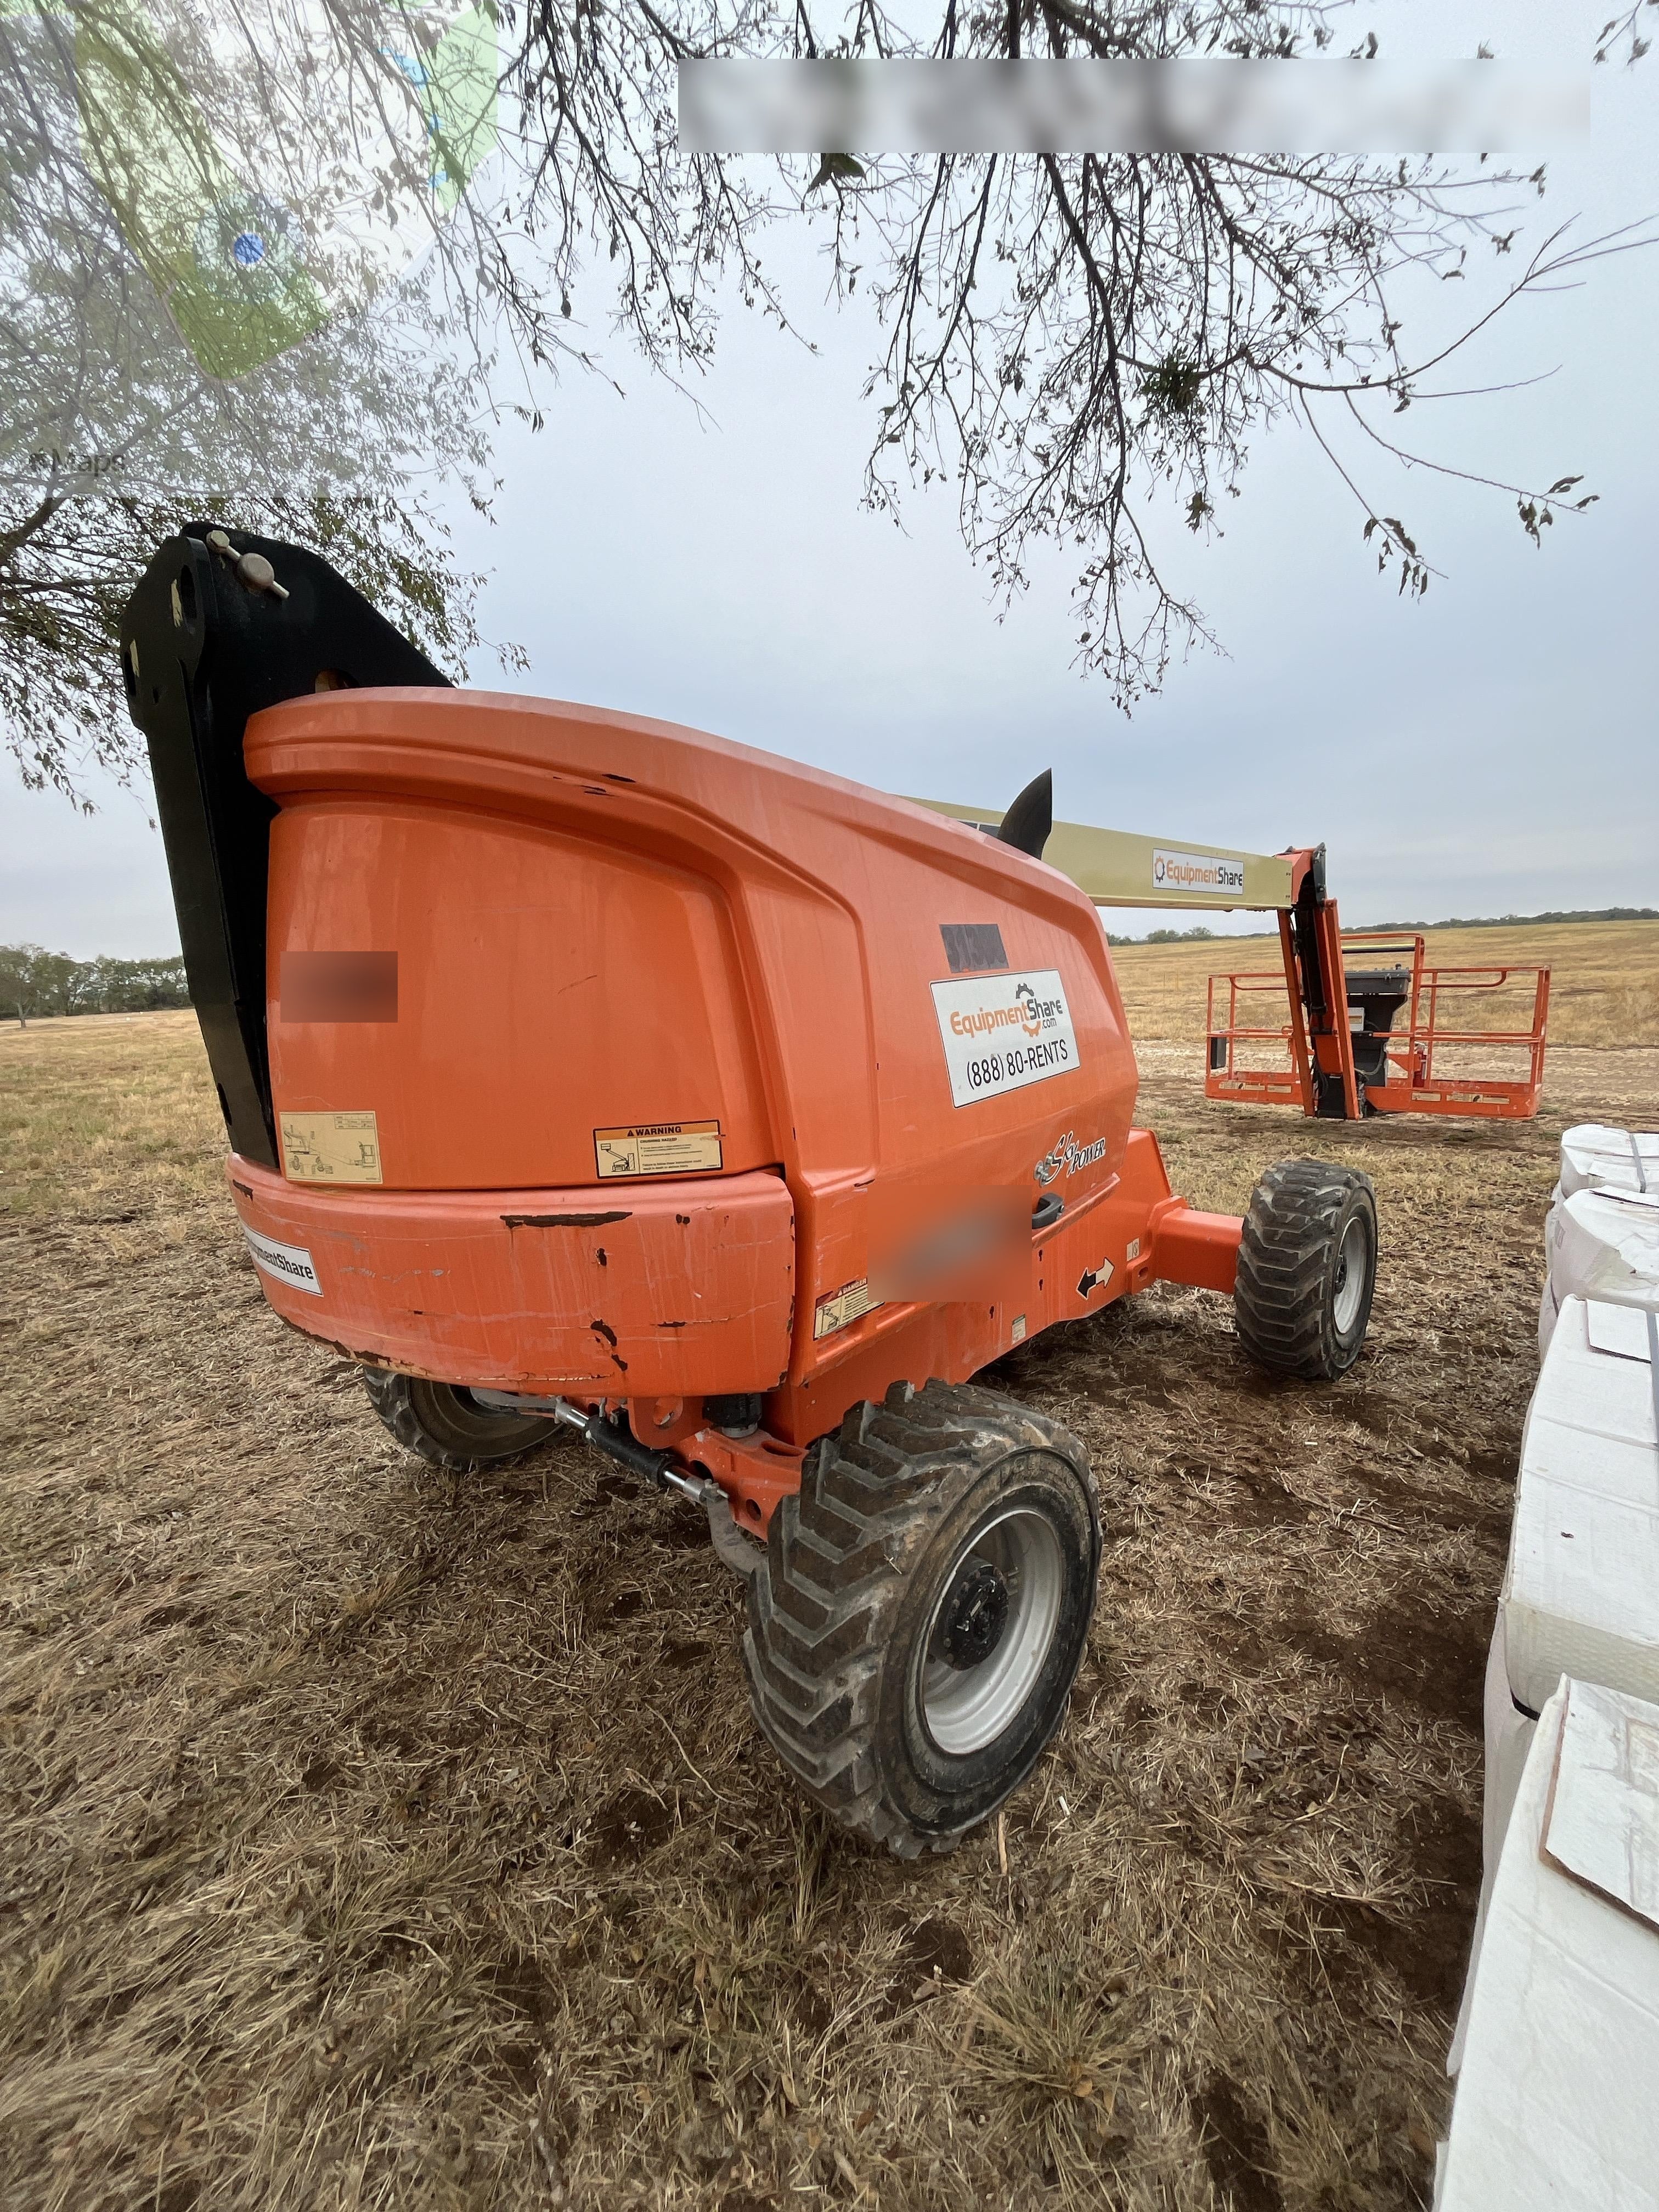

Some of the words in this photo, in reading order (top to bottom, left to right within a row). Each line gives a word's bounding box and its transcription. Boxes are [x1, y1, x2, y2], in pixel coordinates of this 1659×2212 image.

[1166, 859, 1243, 885] EquipmentShare
[950, 998, 1063, 1038] EquipmentShare
[1041, 1017, 1057, 1030] .com
[967, 1052, 1005, 1090] (888)
[1007, 1039, 1068, 1076] 80-RENTS
[635, 1126, 682, 1137] WARNING
